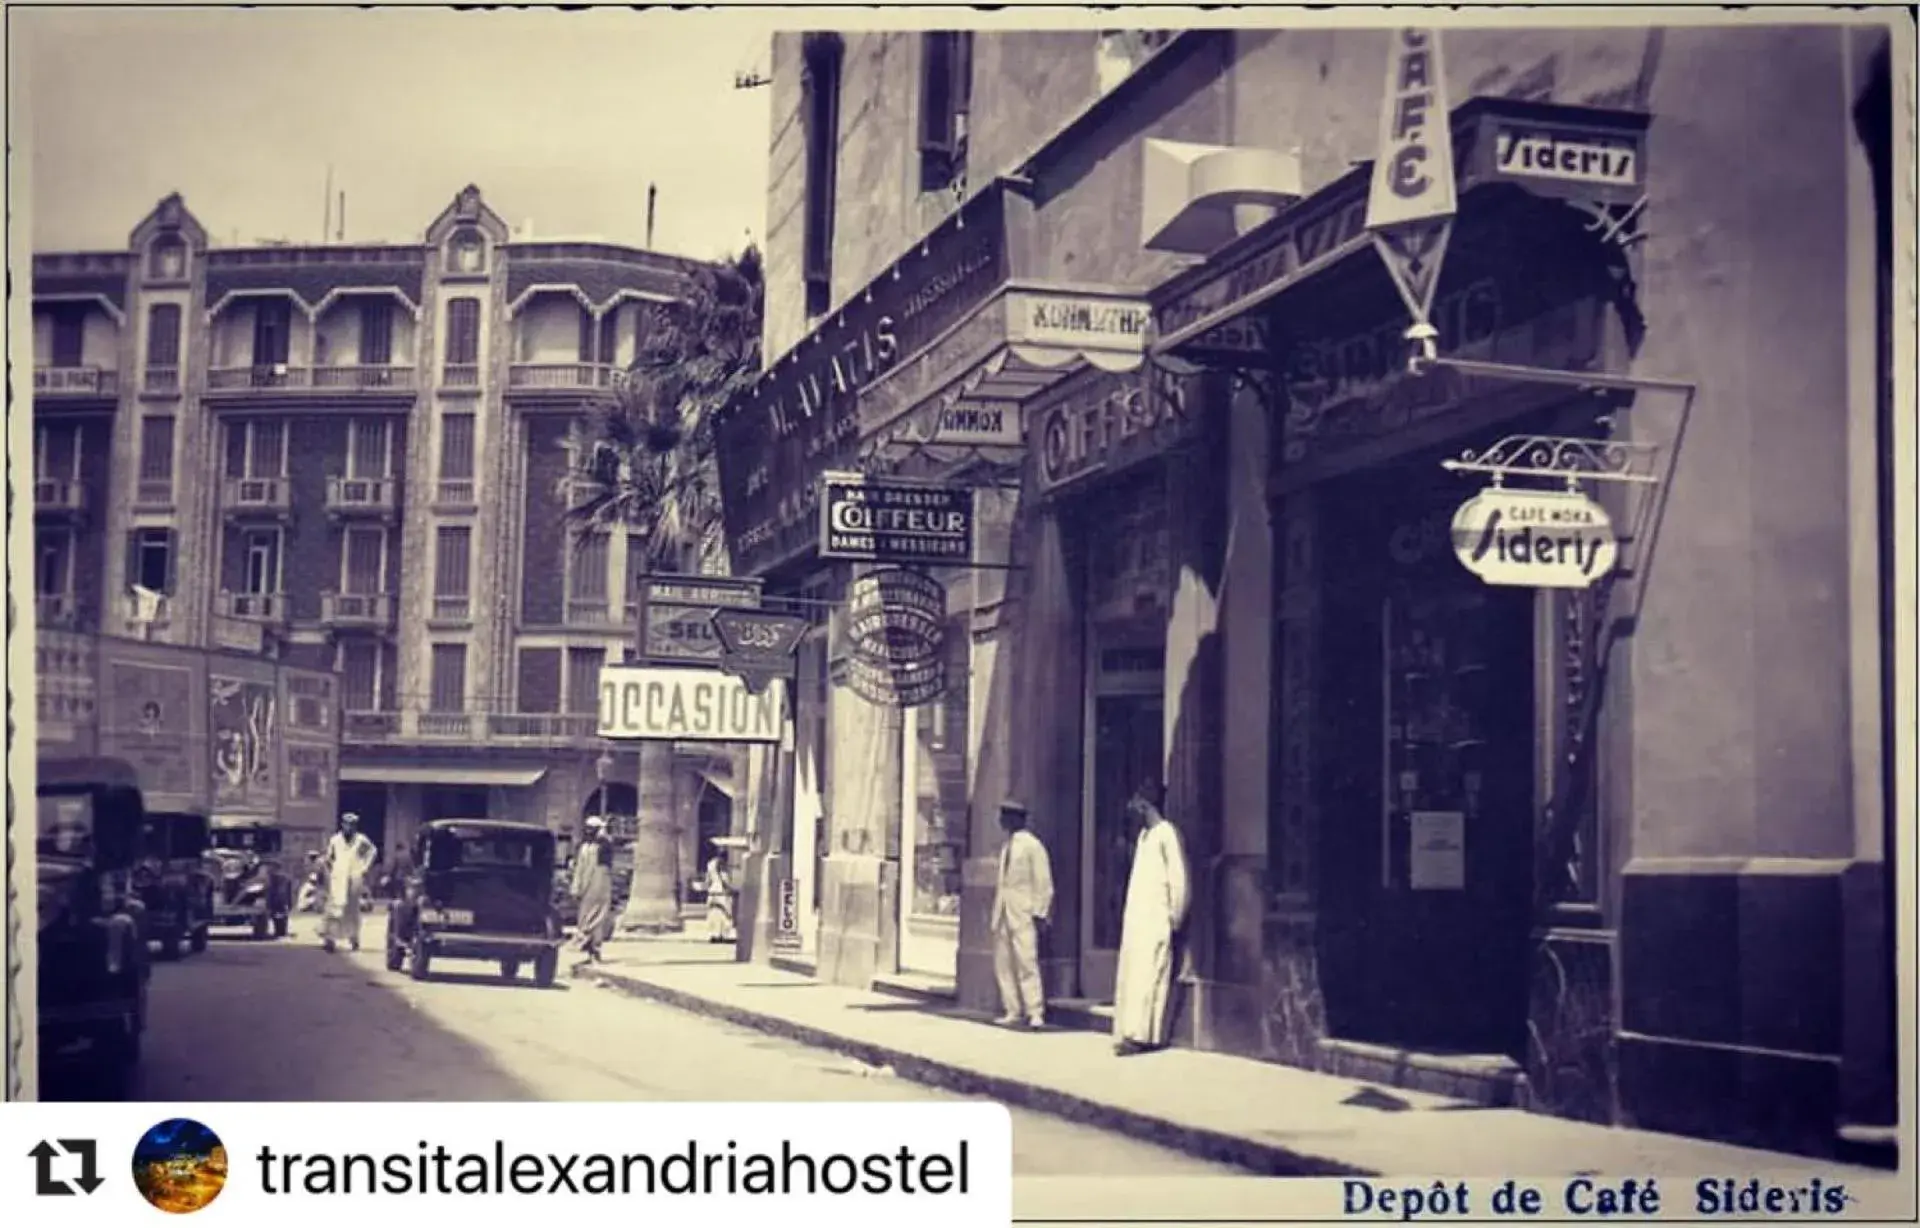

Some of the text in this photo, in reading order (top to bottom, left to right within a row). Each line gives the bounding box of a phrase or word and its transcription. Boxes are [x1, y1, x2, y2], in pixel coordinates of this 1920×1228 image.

[1499, 136, 1631, 178] Sideris
[831, 500, 967, 533] COIFFEUR
[1471, 509, 1602, 575] Sideris
[669, 621, 713, 640] SEL
[601, 680, 774, 736] OCCASION
